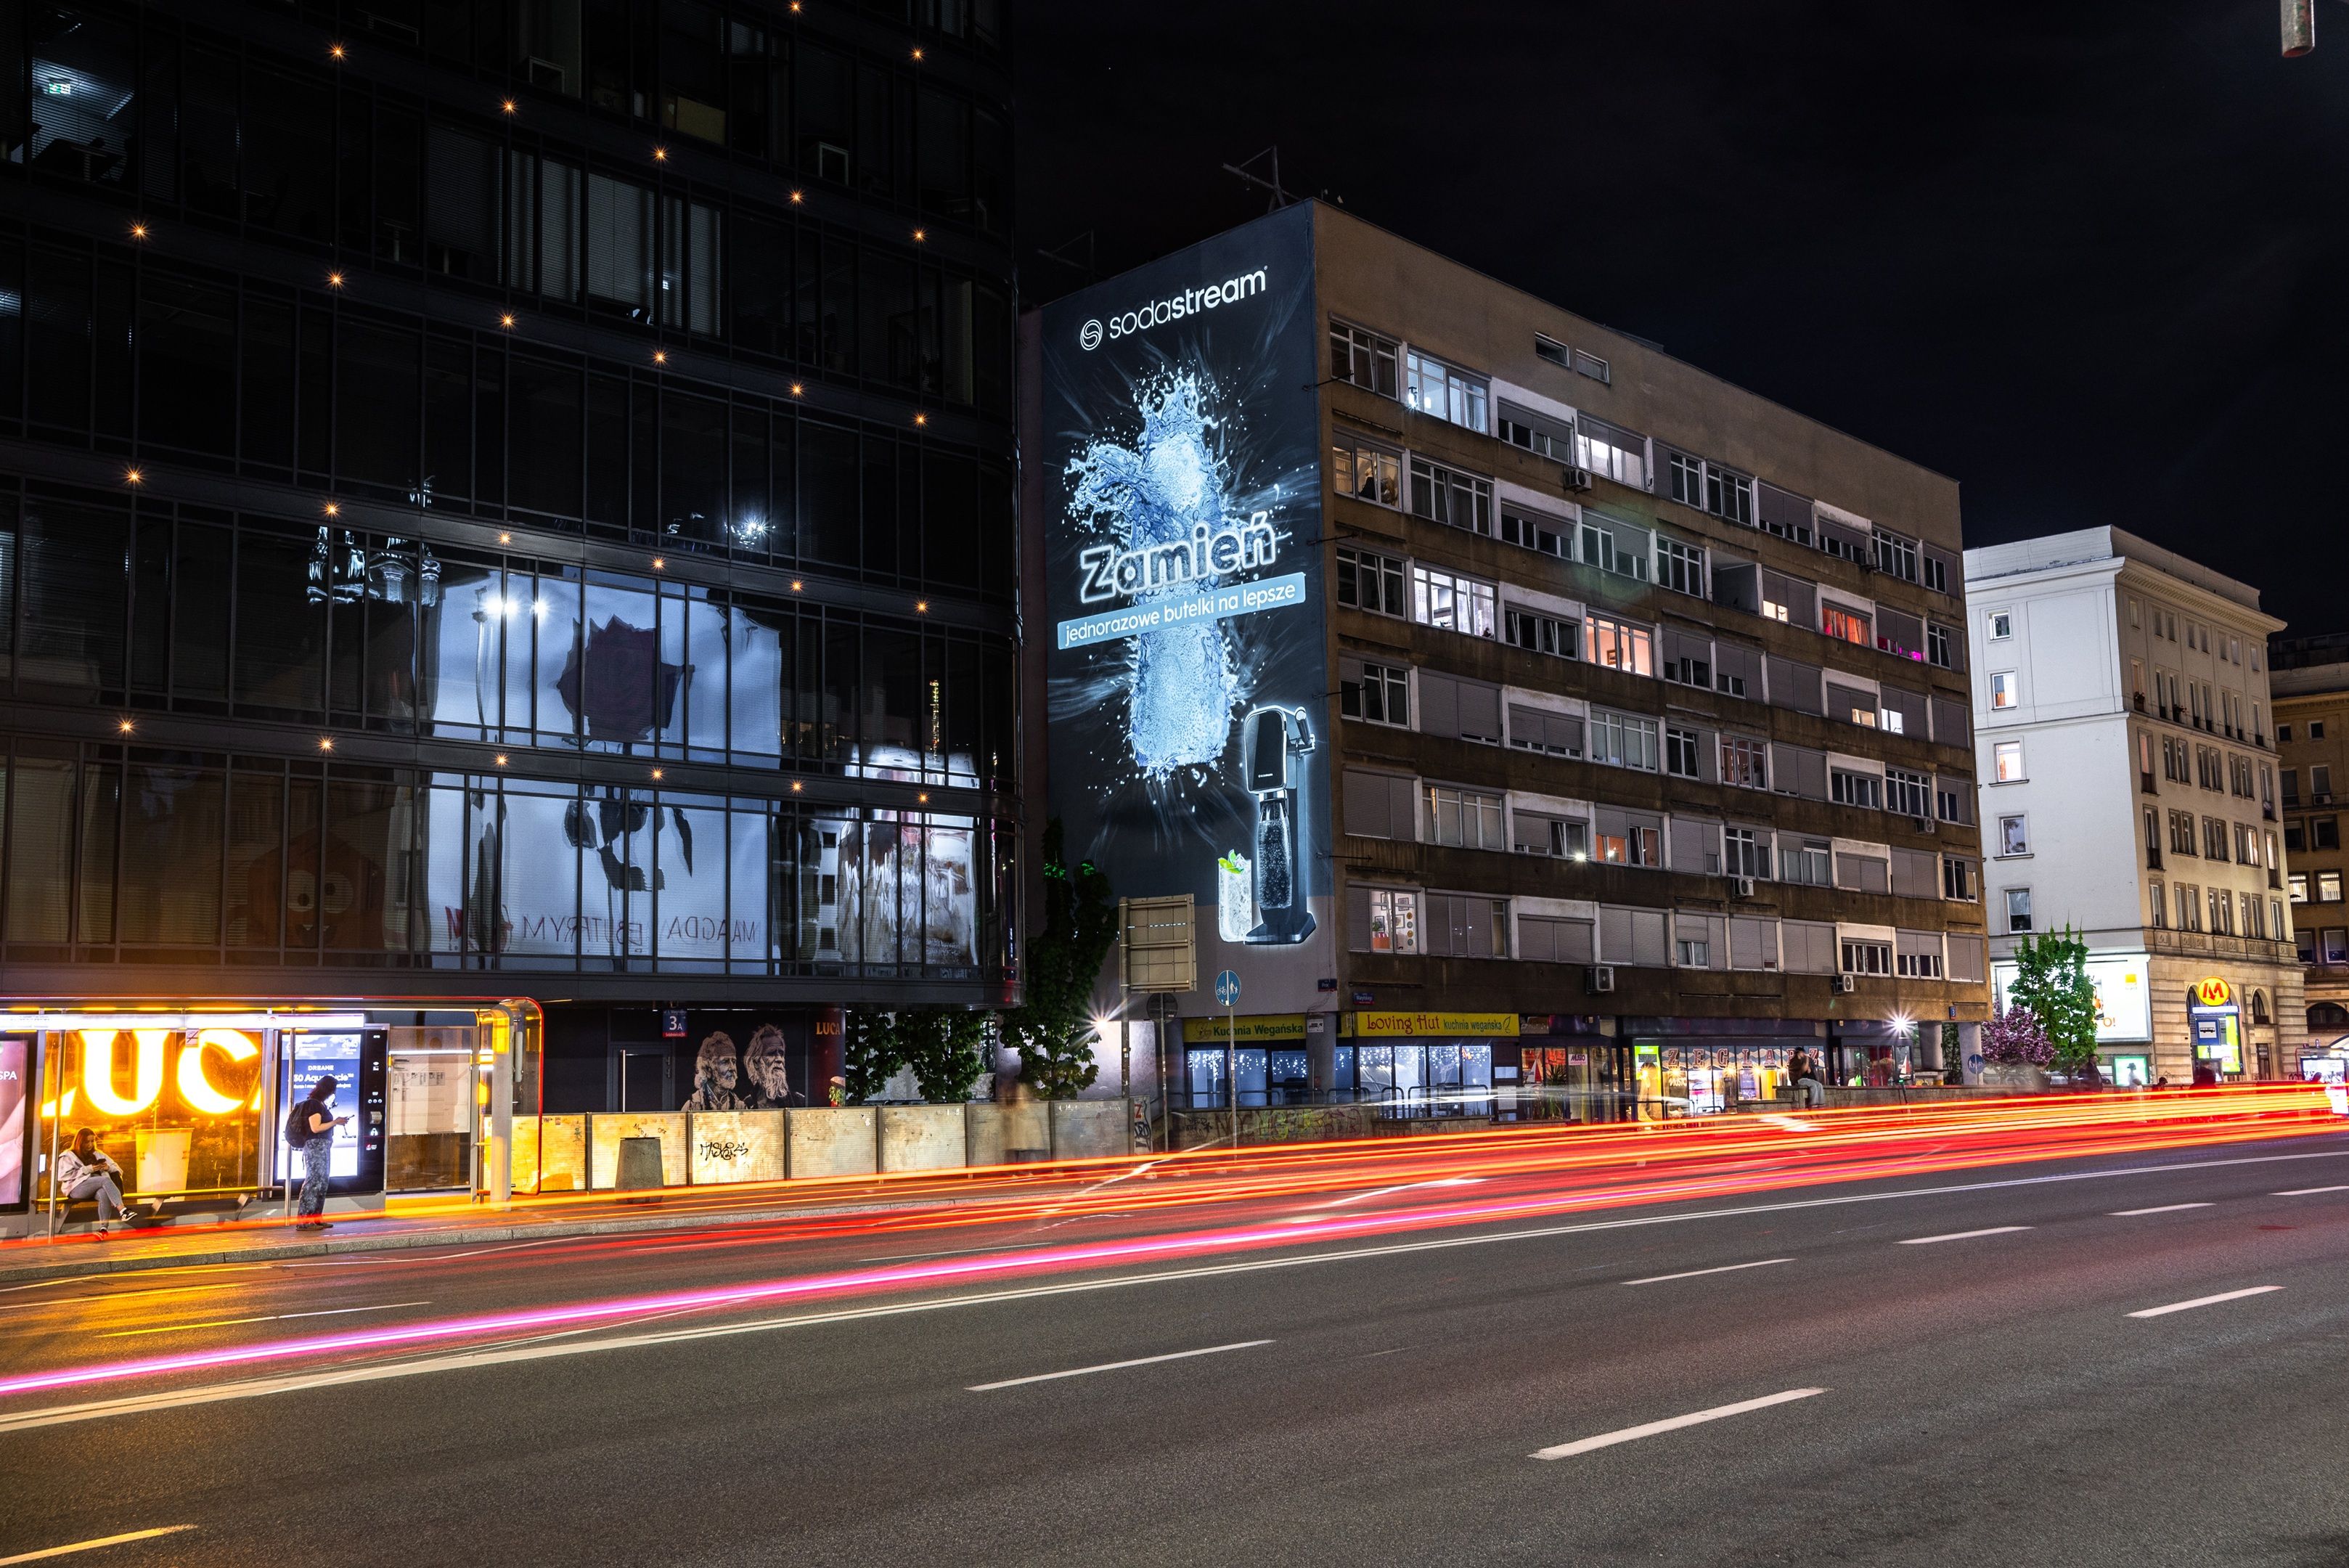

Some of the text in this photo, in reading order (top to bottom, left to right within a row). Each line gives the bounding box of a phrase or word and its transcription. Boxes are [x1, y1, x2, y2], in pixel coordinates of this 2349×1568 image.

[1109, 270, 1266, 339] sodastream
[1080, 510, 1276, 603] Zamień
[1065, 584, 1296, 646] jednorazowe butelki na lepsze
[816, 1021, 841, 1035] LUCA
[1254, 1024, 1303, 1035] Wegańska
[1367, 1014, 1503, 1034] Loving Hut kuchnia wegańska
